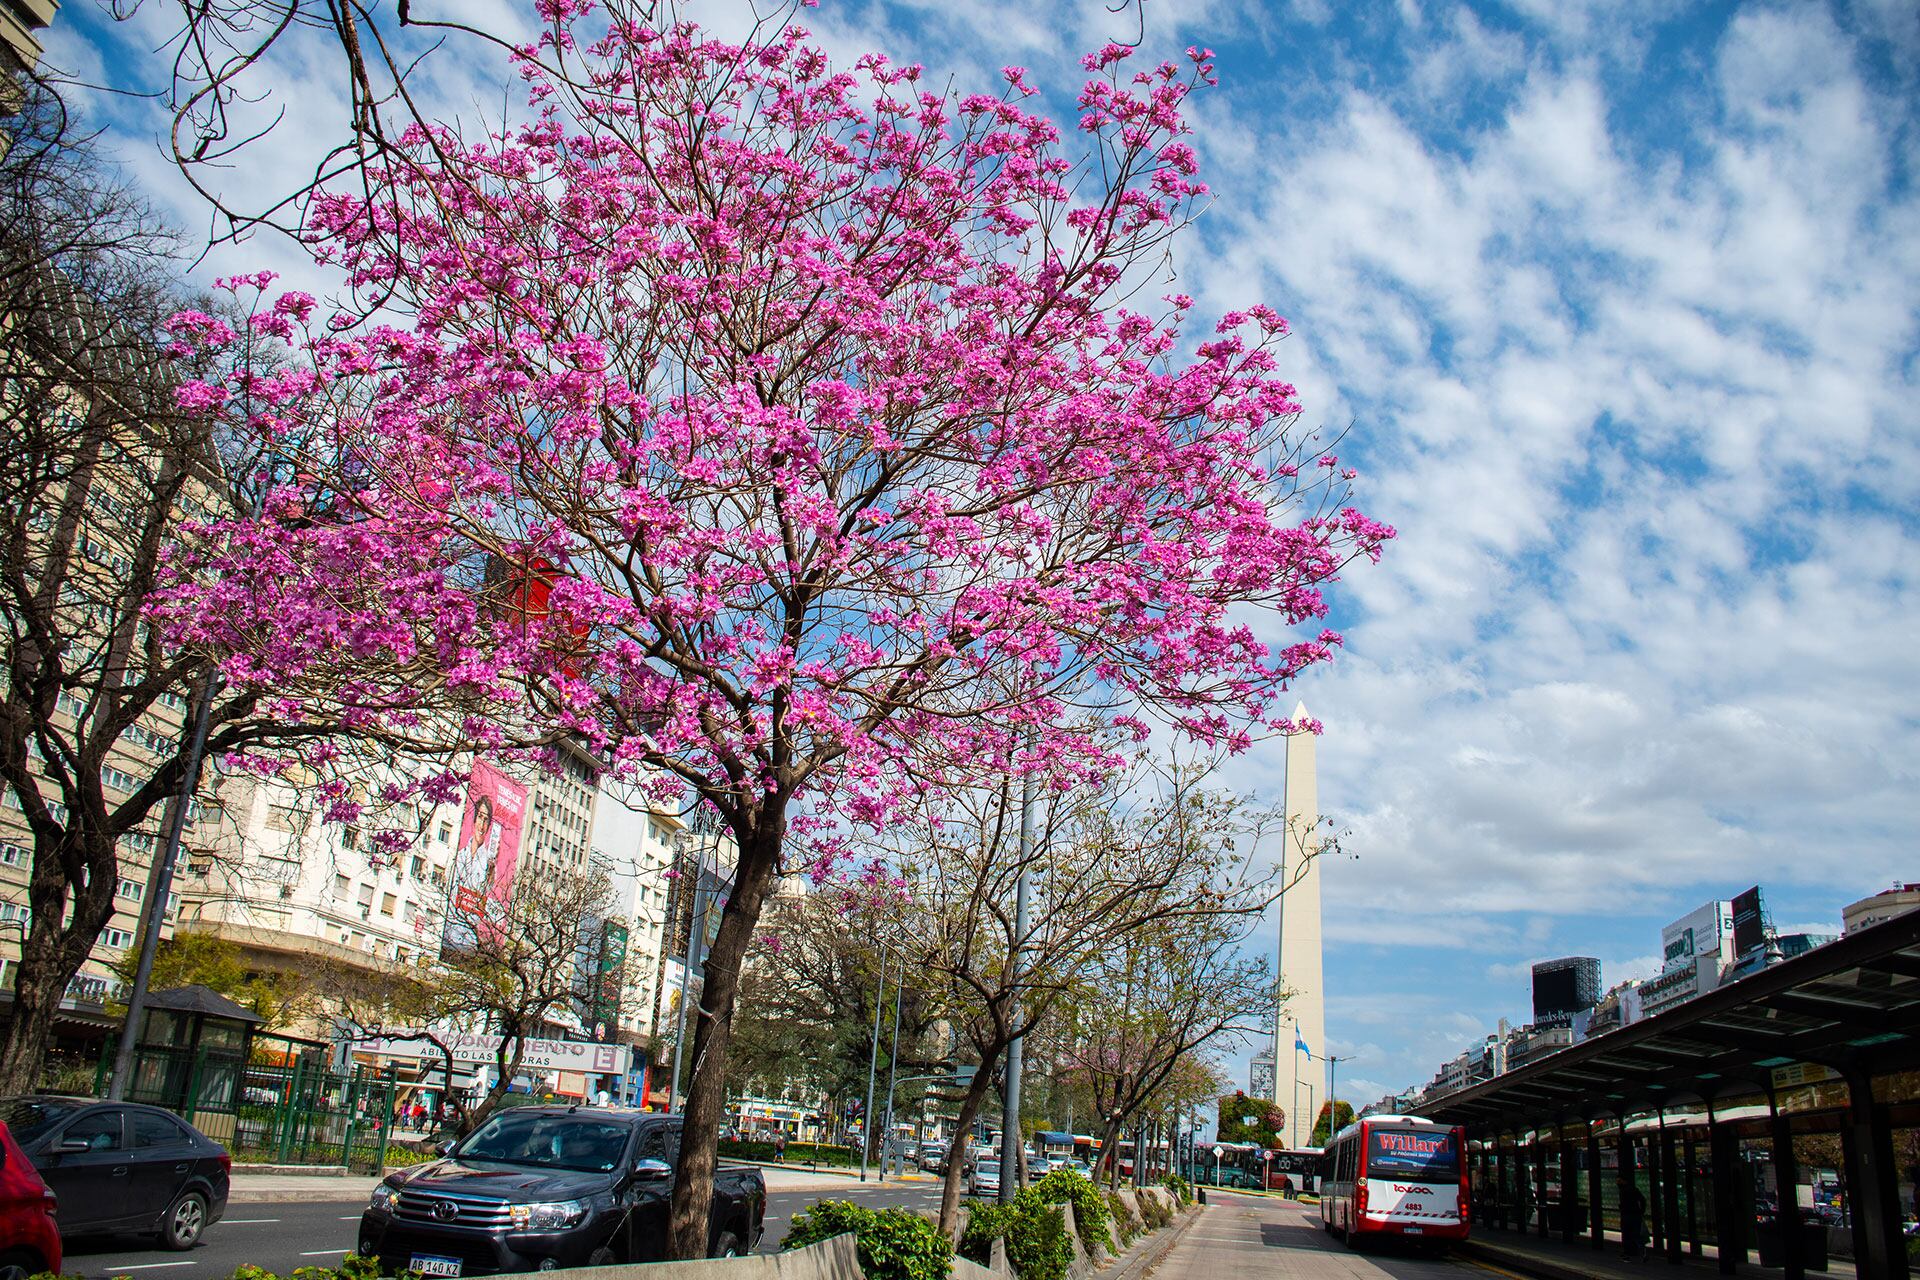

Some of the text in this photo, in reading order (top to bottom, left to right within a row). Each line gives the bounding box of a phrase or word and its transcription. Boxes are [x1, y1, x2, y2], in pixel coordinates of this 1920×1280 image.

[420, 1047, 469, 1060] ABIETO
[472, 1051, 493, 1061] LAS
[519, 1055, 550, 1066] ORAS
[1379, 1134, 1449, 1153] Willard
[1278, 1159, 1291, 1170] 100
[1405, 1203, 1422, 1211] 4883
[411, 1259, 424, 1271] AB
[426, 1261, 444, 1274] 140
[446, 1264, 459, 1276] KZ
